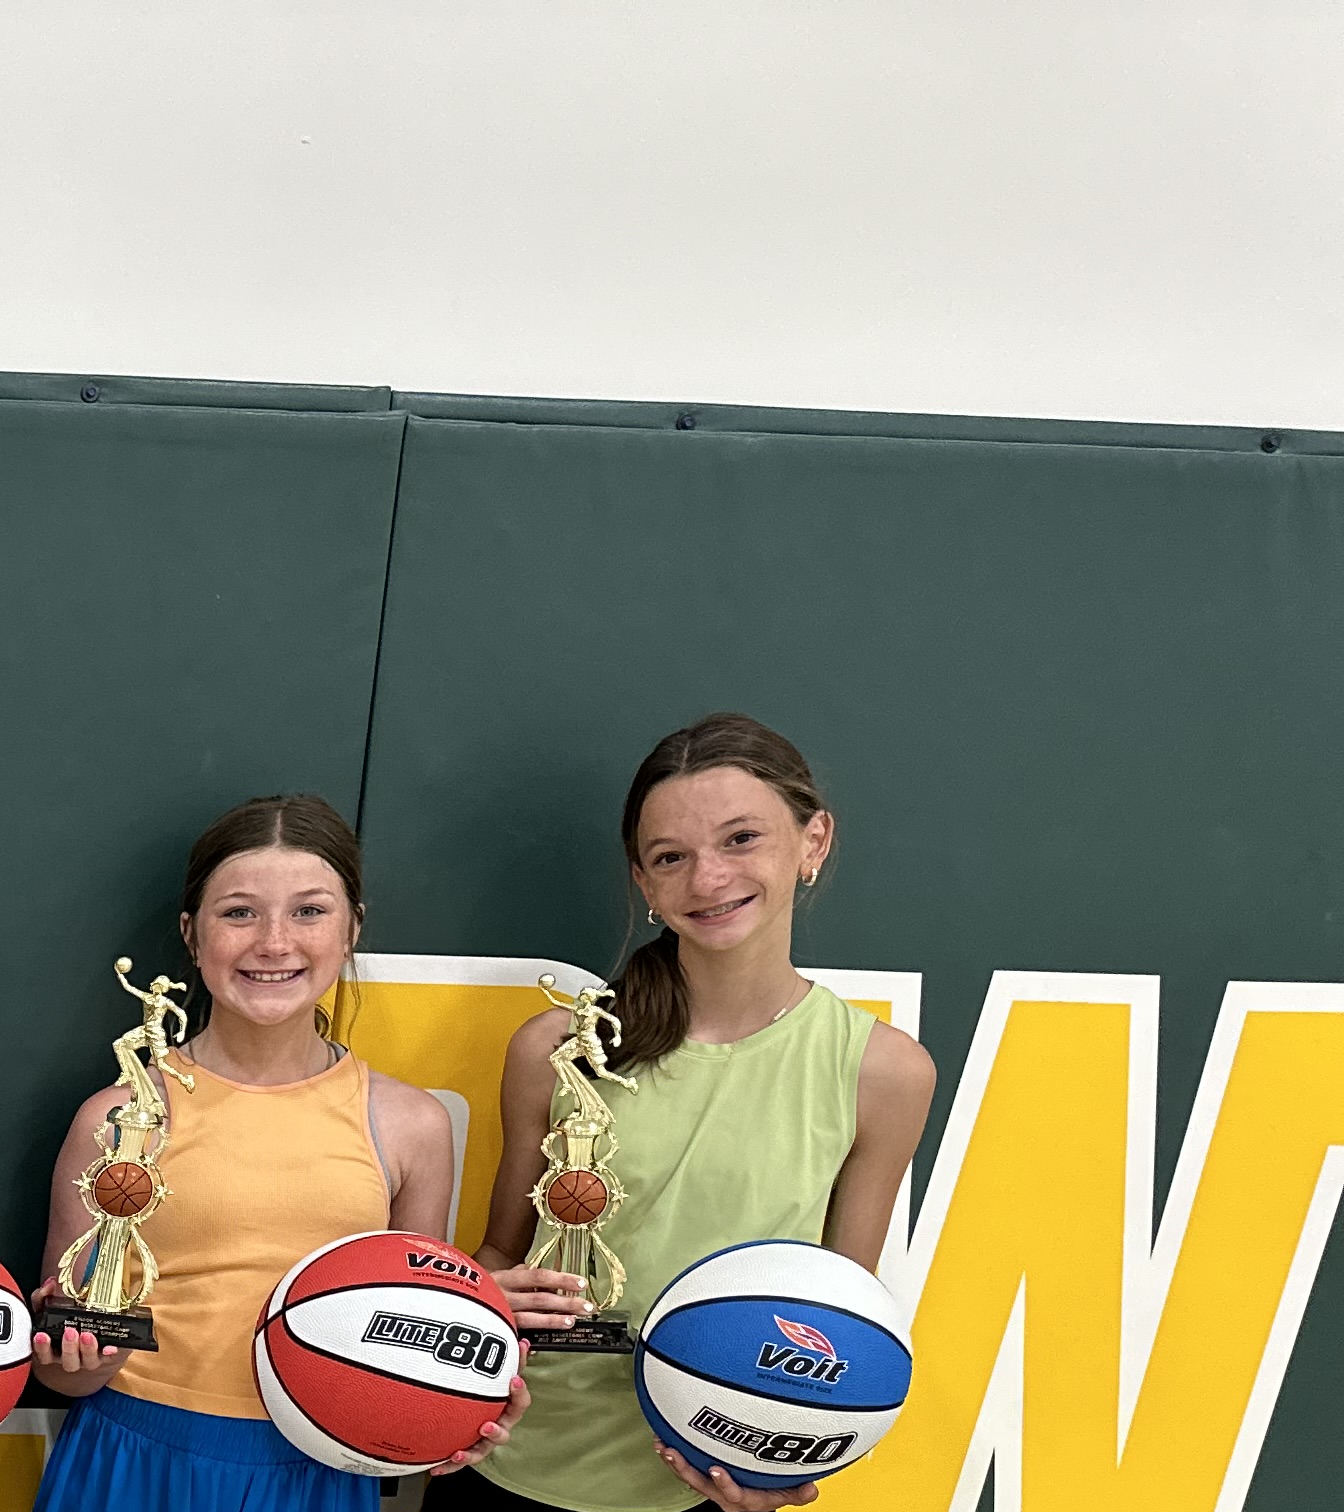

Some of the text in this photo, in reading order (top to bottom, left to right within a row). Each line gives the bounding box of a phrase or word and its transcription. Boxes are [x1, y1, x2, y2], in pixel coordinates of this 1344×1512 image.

[406, 1252, 482, 1285] Voit
[374, 1317, 441, 1347] LITE
[436, 1325, 507, 1376] 80
[756, 1342, 849, 1384] Voit
[696, 1411, 857, 1464] LITE 80
